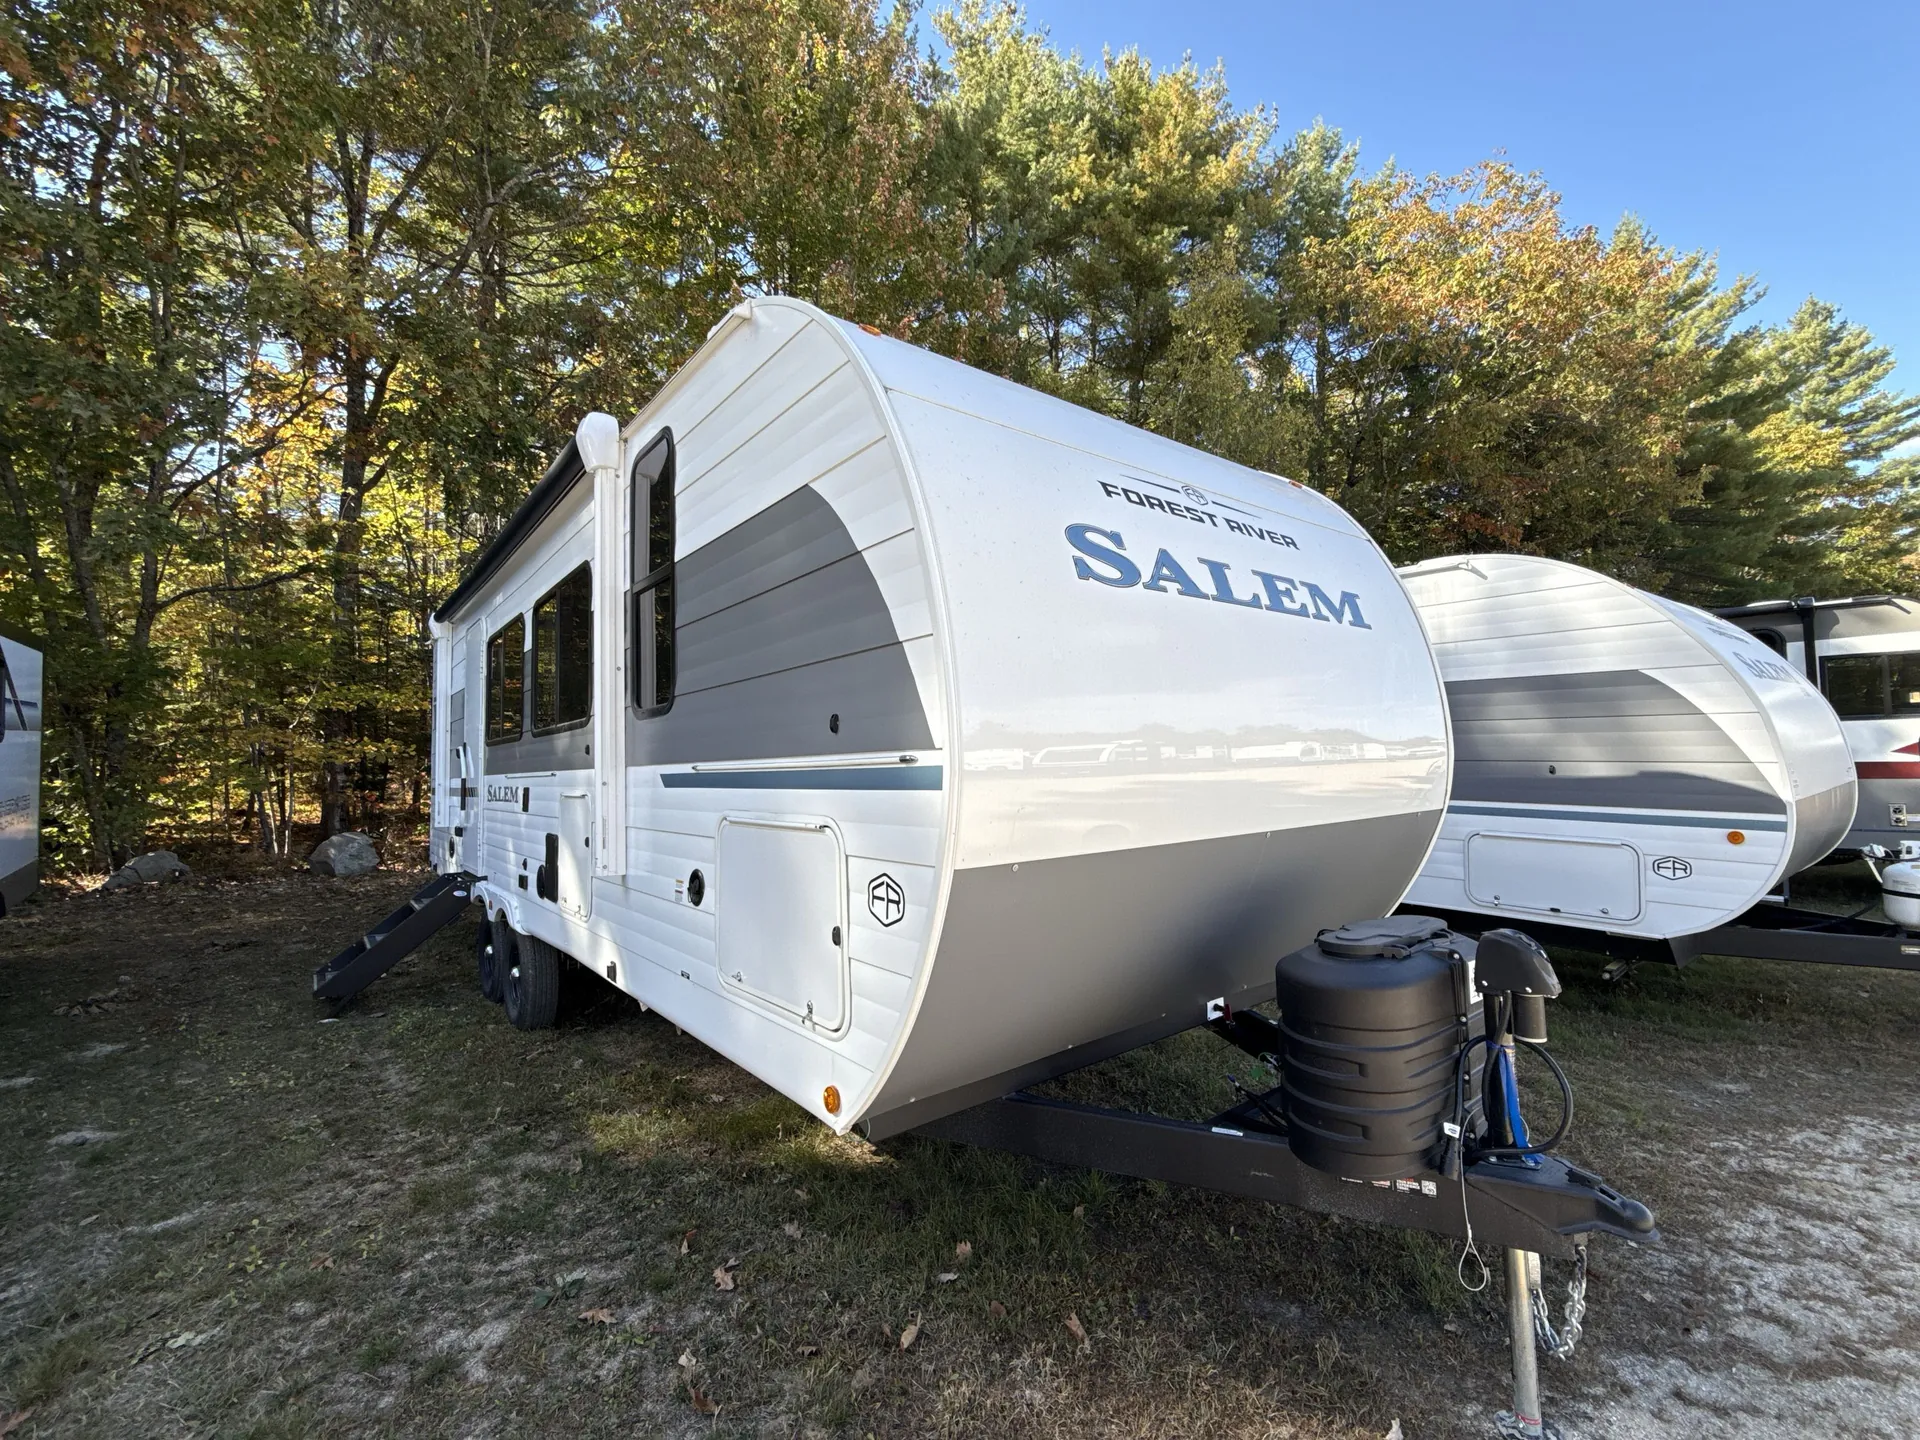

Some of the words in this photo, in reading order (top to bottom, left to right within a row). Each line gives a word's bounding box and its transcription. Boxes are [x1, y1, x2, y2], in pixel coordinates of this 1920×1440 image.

[1097, 480, 1219, 528] FOREST
[1223, 516, 1300, 550] RIVER
[1064, 522, 1373, 630] SALEM
[487, 785, 519, 803] SALEM
